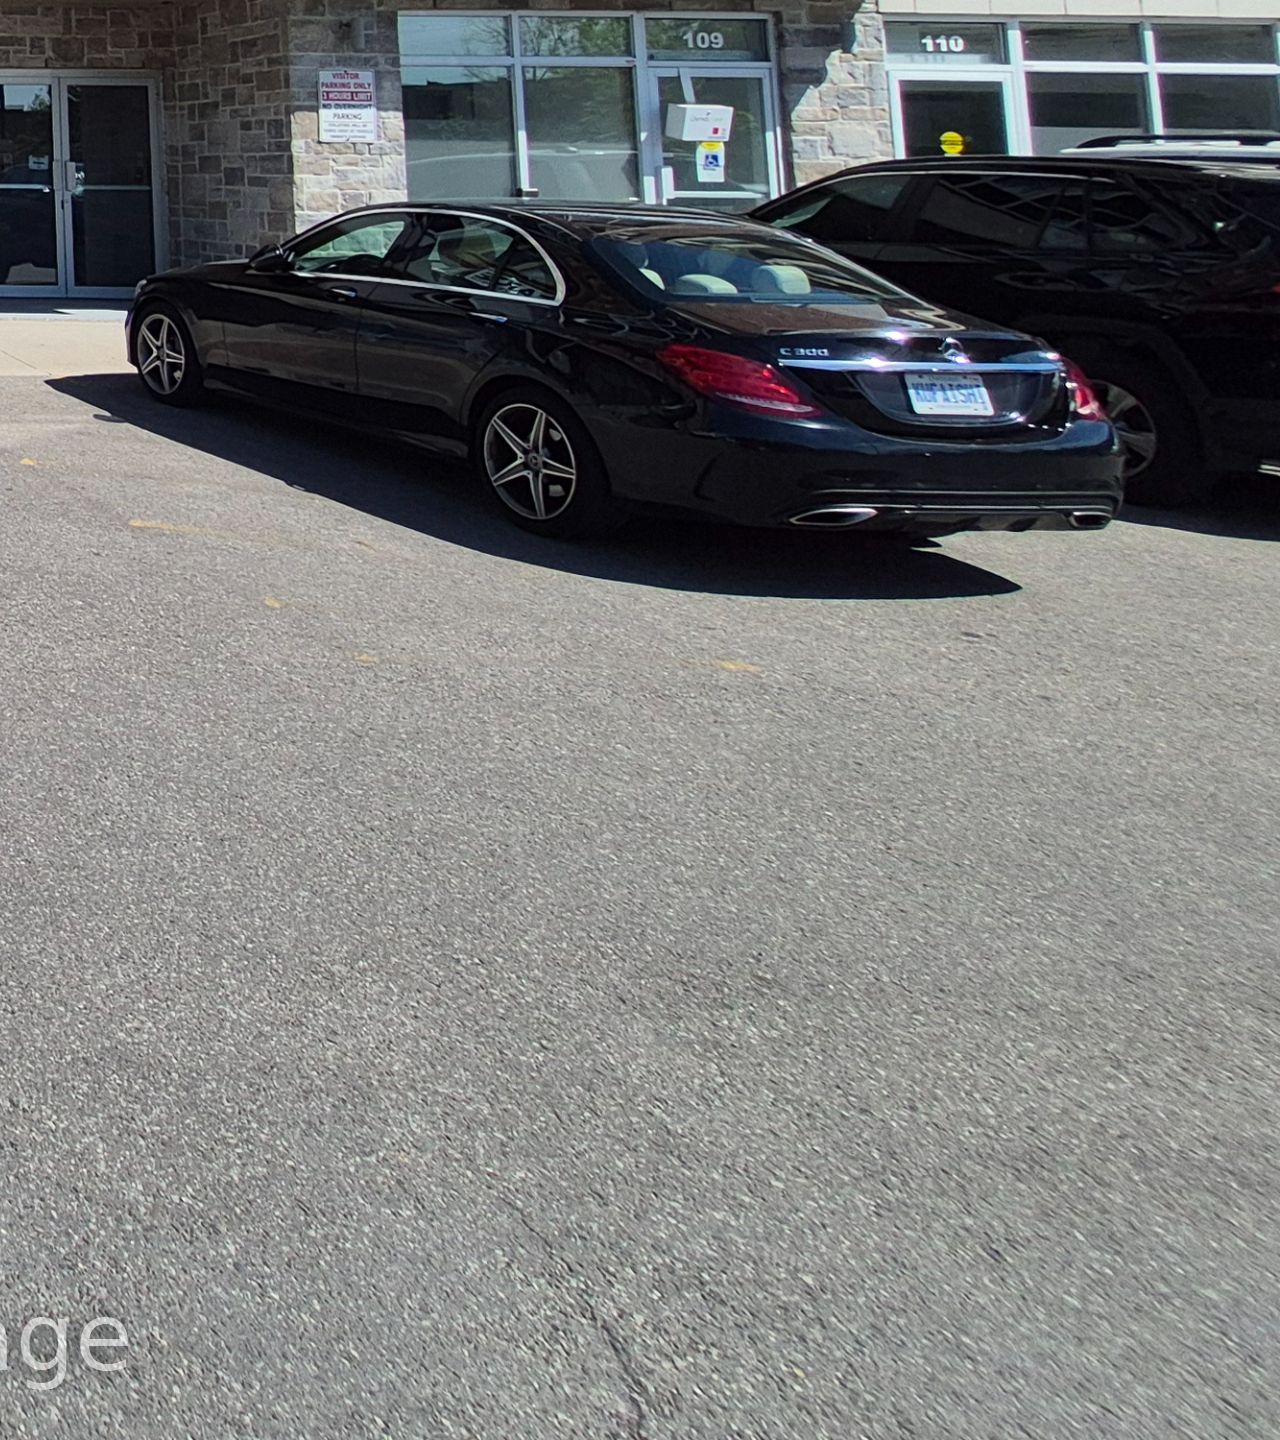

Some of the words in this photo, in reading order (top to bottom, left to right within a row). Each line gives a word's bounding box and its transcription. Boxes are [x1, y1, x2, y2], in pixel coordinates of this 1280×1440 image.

[683, 31, 725, 49] 109
[921, 35, 965, 53] 110
[353, 82, 371, 90] ONLY
[780, 347, 792, 356] C
[795, 347, 830, 357] 300
